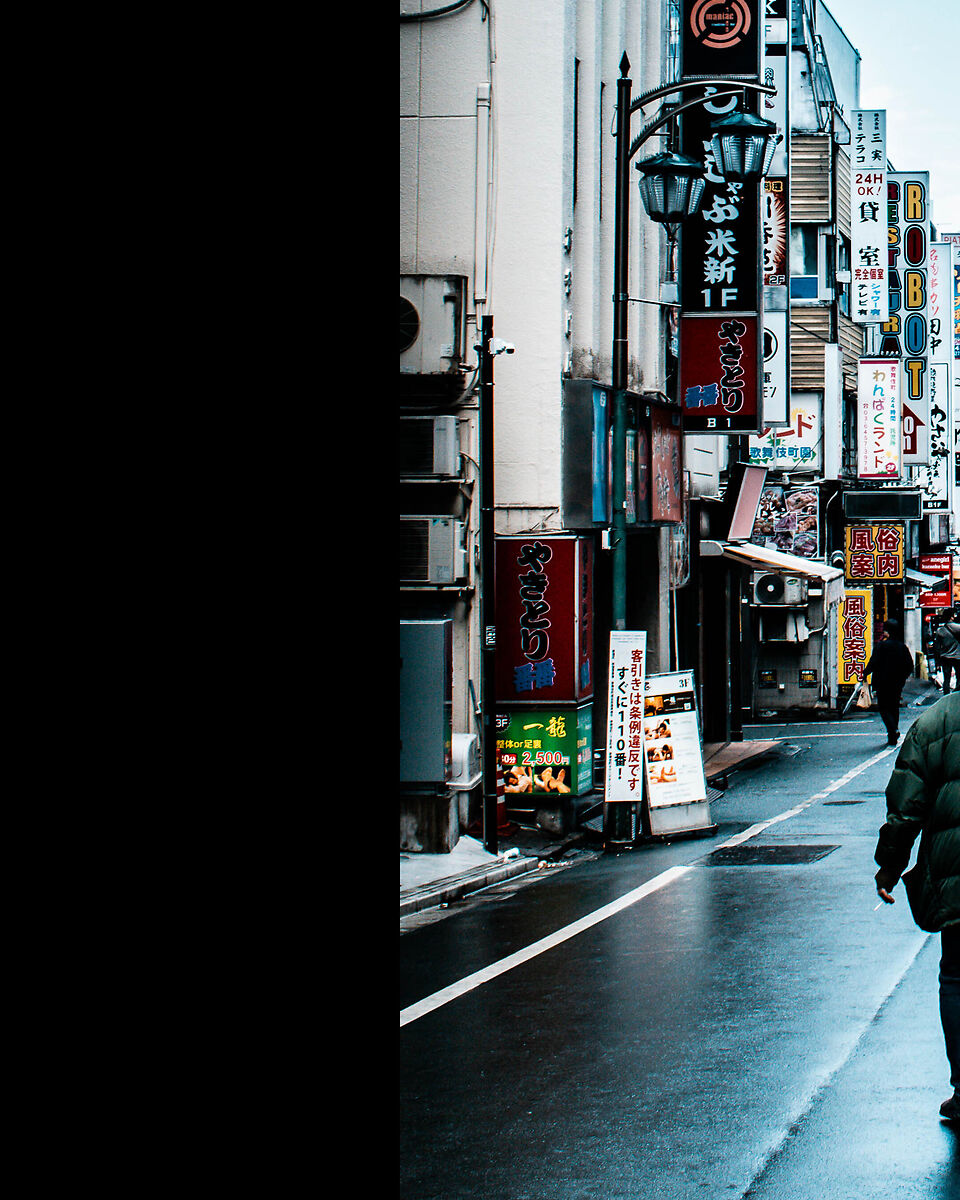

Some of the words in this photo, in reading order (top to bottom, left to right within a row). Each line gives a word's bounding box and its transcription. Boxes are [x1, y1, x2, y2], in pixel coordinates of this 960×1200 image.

[855, 133, 866, 163] テラコ
[855, 173, 883, 184] 24H
[857, 186, 882, 196] OK!
[769, 275, 785, 285] 2F
[855, 268, 884, 280] 完全個室
[903, 181, 927, 400] ROBOT
[718, 320, 747, 413] やきとり
[849, 528, 900, 551] 風俗
[850, 553, 899, 577] 案内
[517, 541, 552, 660] やきとり
[842, 596, 868, 682] 風俗案内
[523, 716, 566, 737] 一龍
[627, 649, 644, 798] 客引きは条例違反です。
